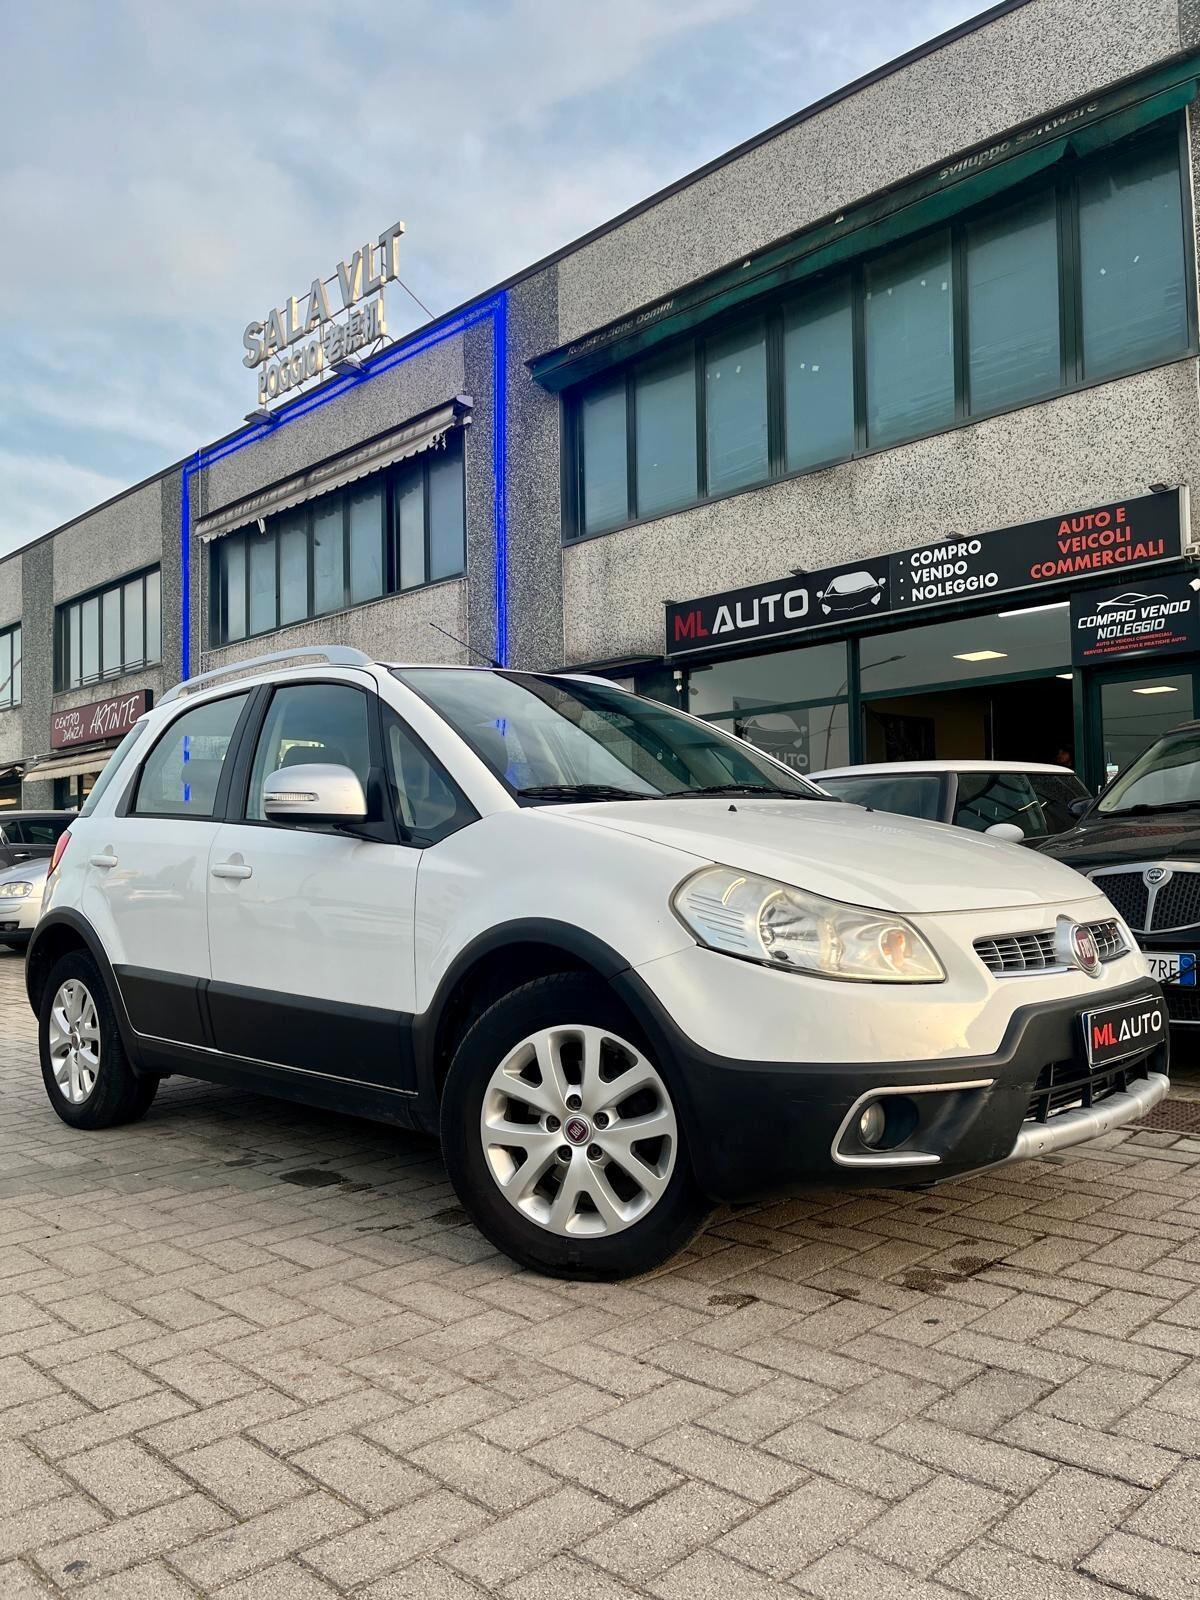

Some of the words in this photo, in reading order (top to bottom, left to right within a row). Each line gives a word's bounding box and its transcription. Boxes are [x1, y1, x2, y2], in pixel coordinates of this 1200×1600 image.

[242, 278, 332, 369] SALA
[336, 221, 405, 309] VLT
[258, 340, 323, 405] POGGIO
[1058, 511, 1110, 537] AUTO
[1116, 507, 1126, 523] E
[910, 539, 982, 567] COMPRO
[1058, 526, 1131, 555] VEICOLI
[911, 560, 968, 584] VENDO
[1030, 539, 1164, 580] COMMERCIALI
[911, 572, 999, 602] NOLEGGIO
[712, 588, 809, 635] AUTO
[1078, 609, 1137, 629] COMPRO
[1141, 600, 1191, 619] VENDO
[1097, 618, 1165, 640] NOLEGGIO
[54, 712, 80, 730] CENTRO
[62, 724, 84, 743] DANZA
[769, 752, 809, 767] UTO
[1118, 1010, 1162, 1042] AUTO
